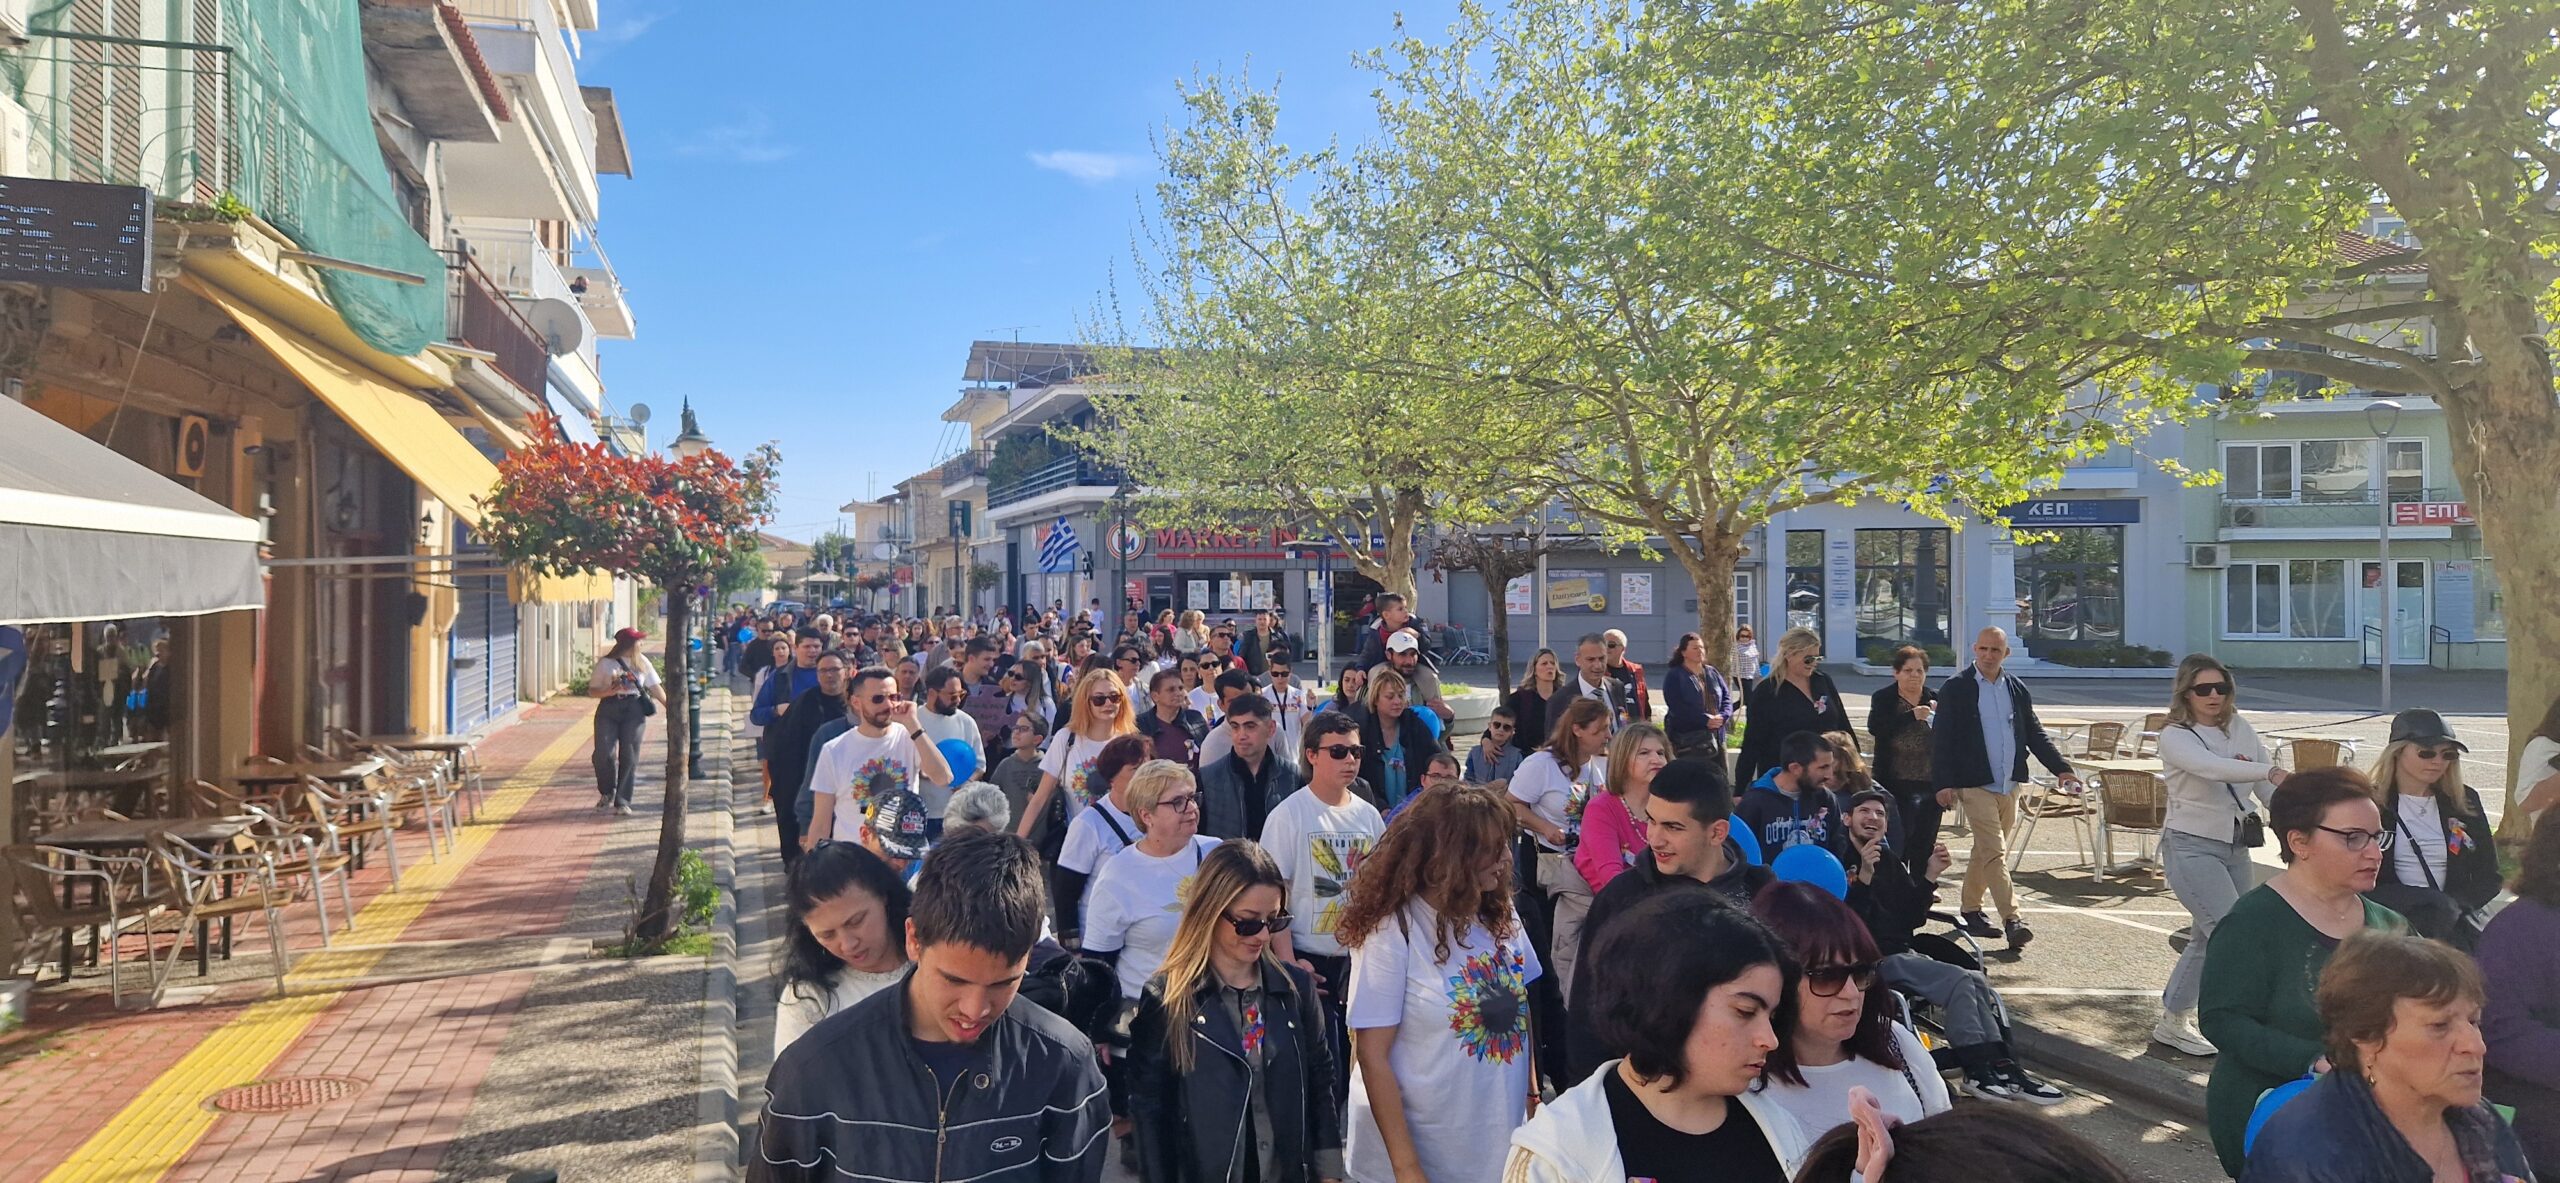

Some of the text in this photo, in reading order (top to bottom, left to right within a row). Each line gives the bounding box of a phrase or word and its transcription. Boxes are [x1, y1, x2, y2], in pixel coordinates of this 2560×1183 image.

[2028, 502, 2069, 516] ΚΕΠ
[1156, 526, 1258, 549] MARKET
[1270, 527, 1297, 548] IN
